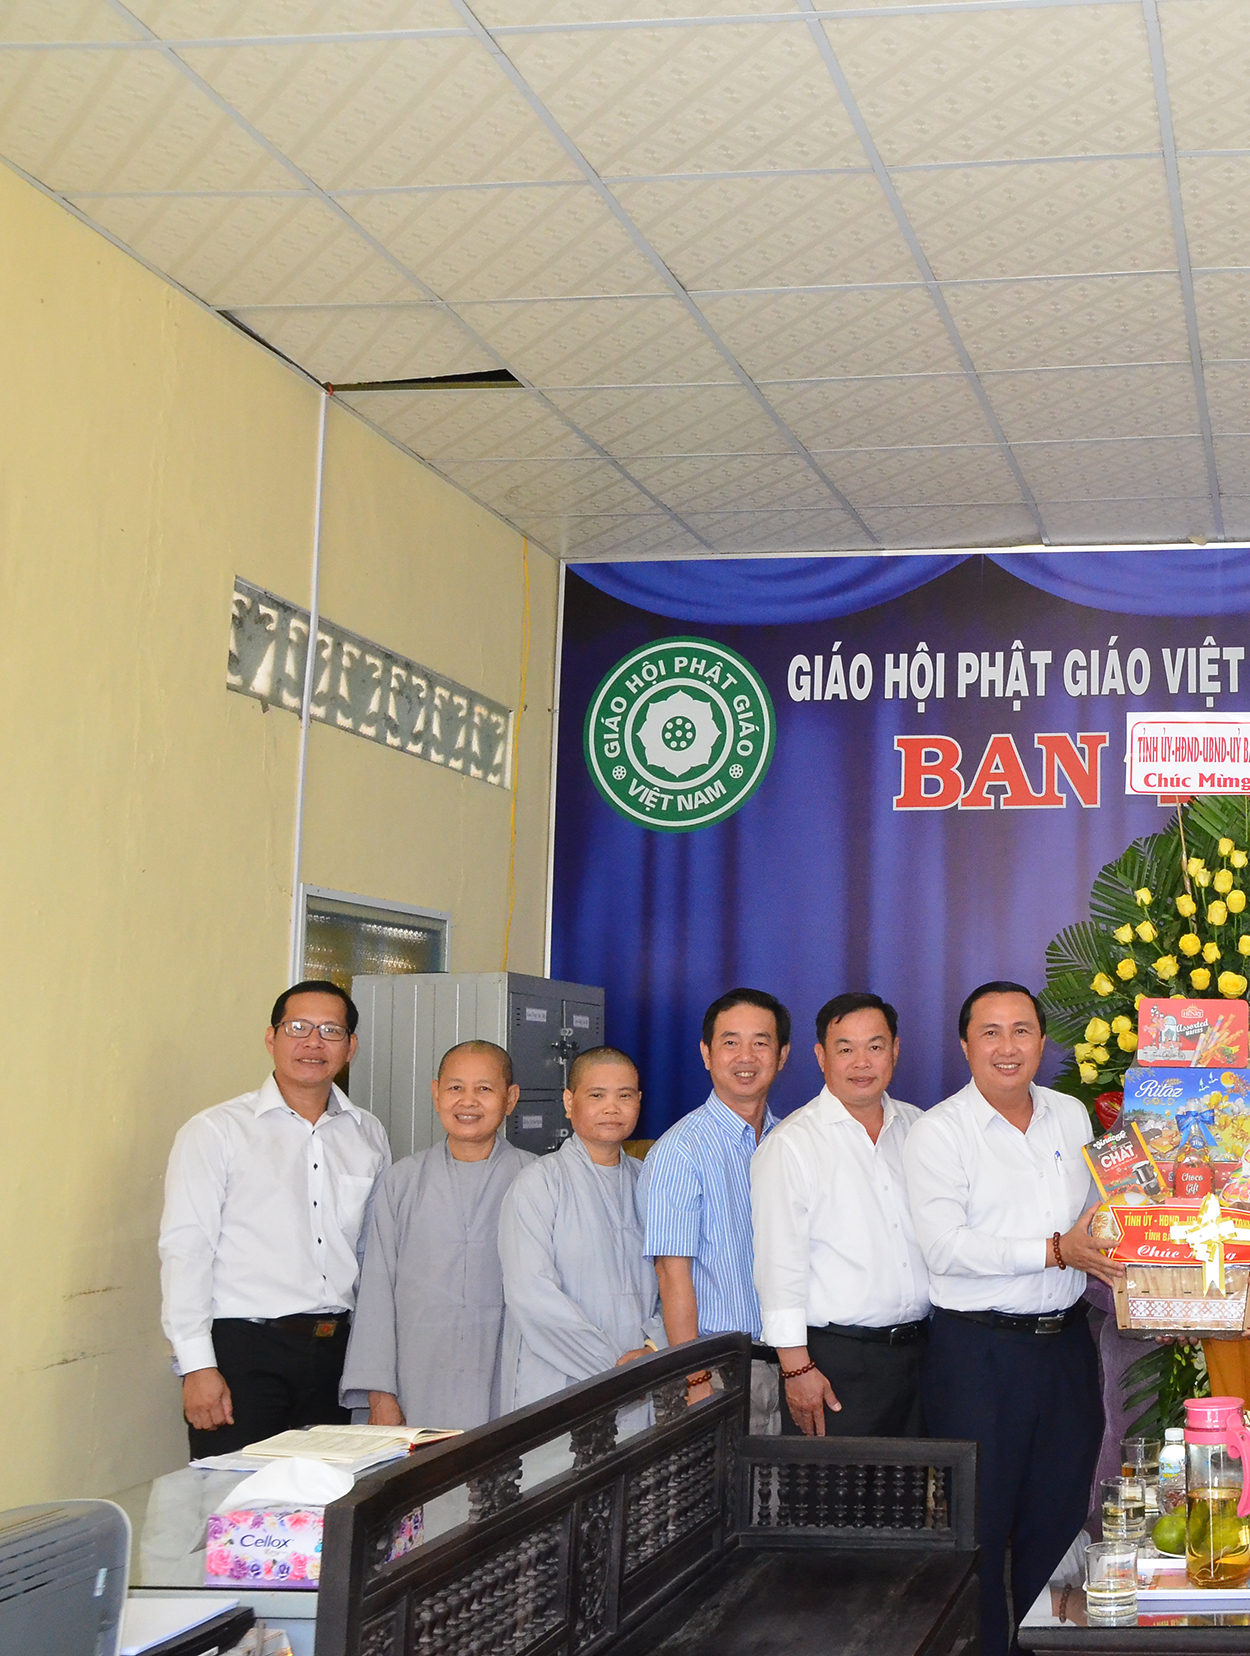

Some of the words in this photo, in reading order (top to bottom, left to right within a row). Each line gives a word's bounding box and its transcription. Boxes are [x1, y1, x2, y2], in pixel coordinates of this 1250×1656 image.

[787, 641, 873, 702] GIÁO
[884, 642, 945, 713] HỘI
[957, 639, 1052, 711] PHẬT
[1063, 636, 1151, 696] GIÁO
[1162, 636, 1245, 708] VIỆT
[601, 696, 627, 758] GIÁO
[624, 660, 666, 694] HỘI
[674, 656, 738, 690] PHẬT
[732, 694, 760, 757] GIÁO
[1137, 727, 1158, 763] TỈNH
[892, 731, 1109, 811] BAN
[1143, 772, 1191, 788] Chúc
[627, 778, 674, 811] VIỆT
[676, 779, 728, 812] NAM
[1135, 1079, 1184, 1098] Ritaz
[1142, 1097, 1175, 1106] GOLD
[1181, 1172, 1204, 1182] Choco
[1185, 1182, 1199, 1195] Gift
[1124, 1212, 1141, 1226] TỈNH
[1143, 1211, 1153, 1226] ỦY
[1145, 1229, 1161, 1241] TỈNH
[1137, 1244, 1180, 1259] Chúc
[240, 1534, 292, 1549] Cellox
